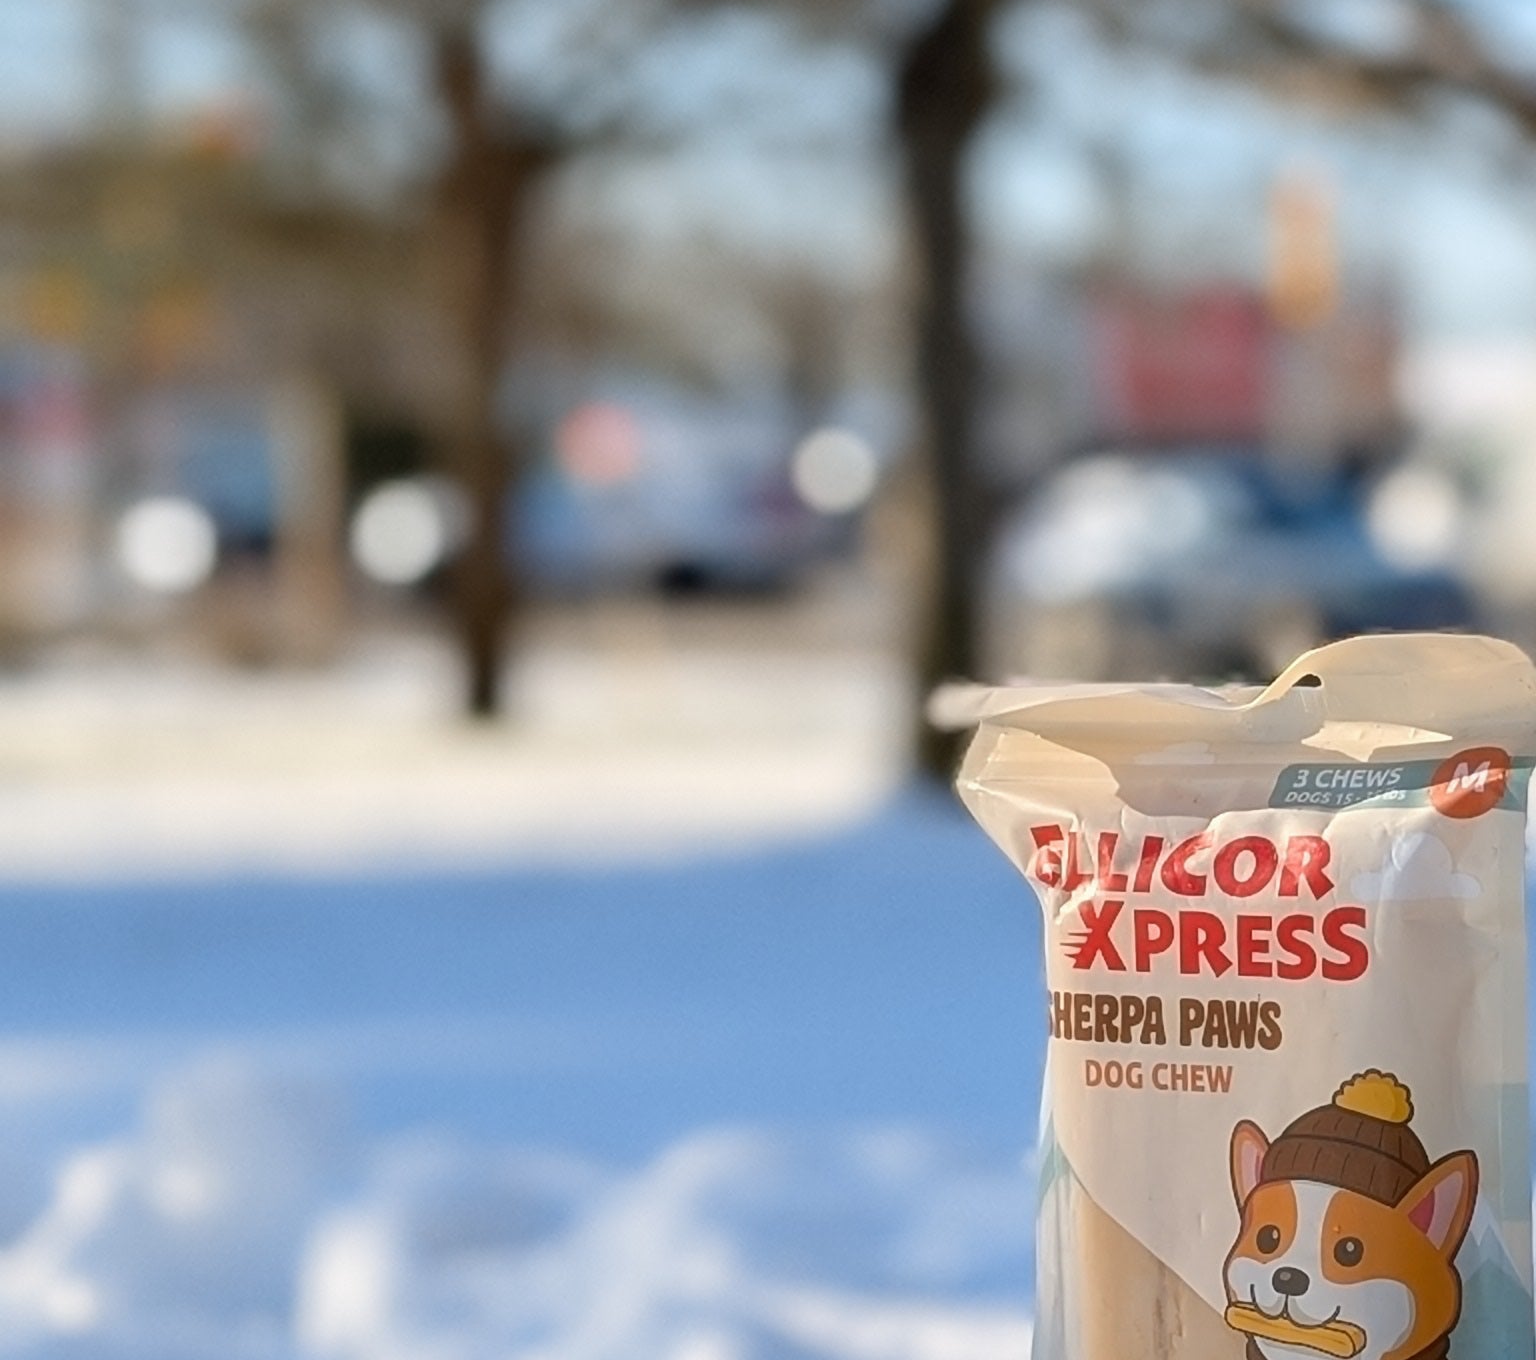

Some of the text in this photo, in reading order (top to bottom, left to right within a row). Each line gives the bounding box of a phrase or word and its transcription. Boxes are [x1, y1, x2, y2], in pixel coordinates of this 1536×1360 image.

[1293, 767, 1404, 788] 3 CHEWS
[1446, 761, 1491, 793] M
[1284, 791, 1331, 804] DOGS
[1179, 997, 1283, 1051] PAWS
[1085, 1059, 1233, 1093] DOG CHEW
